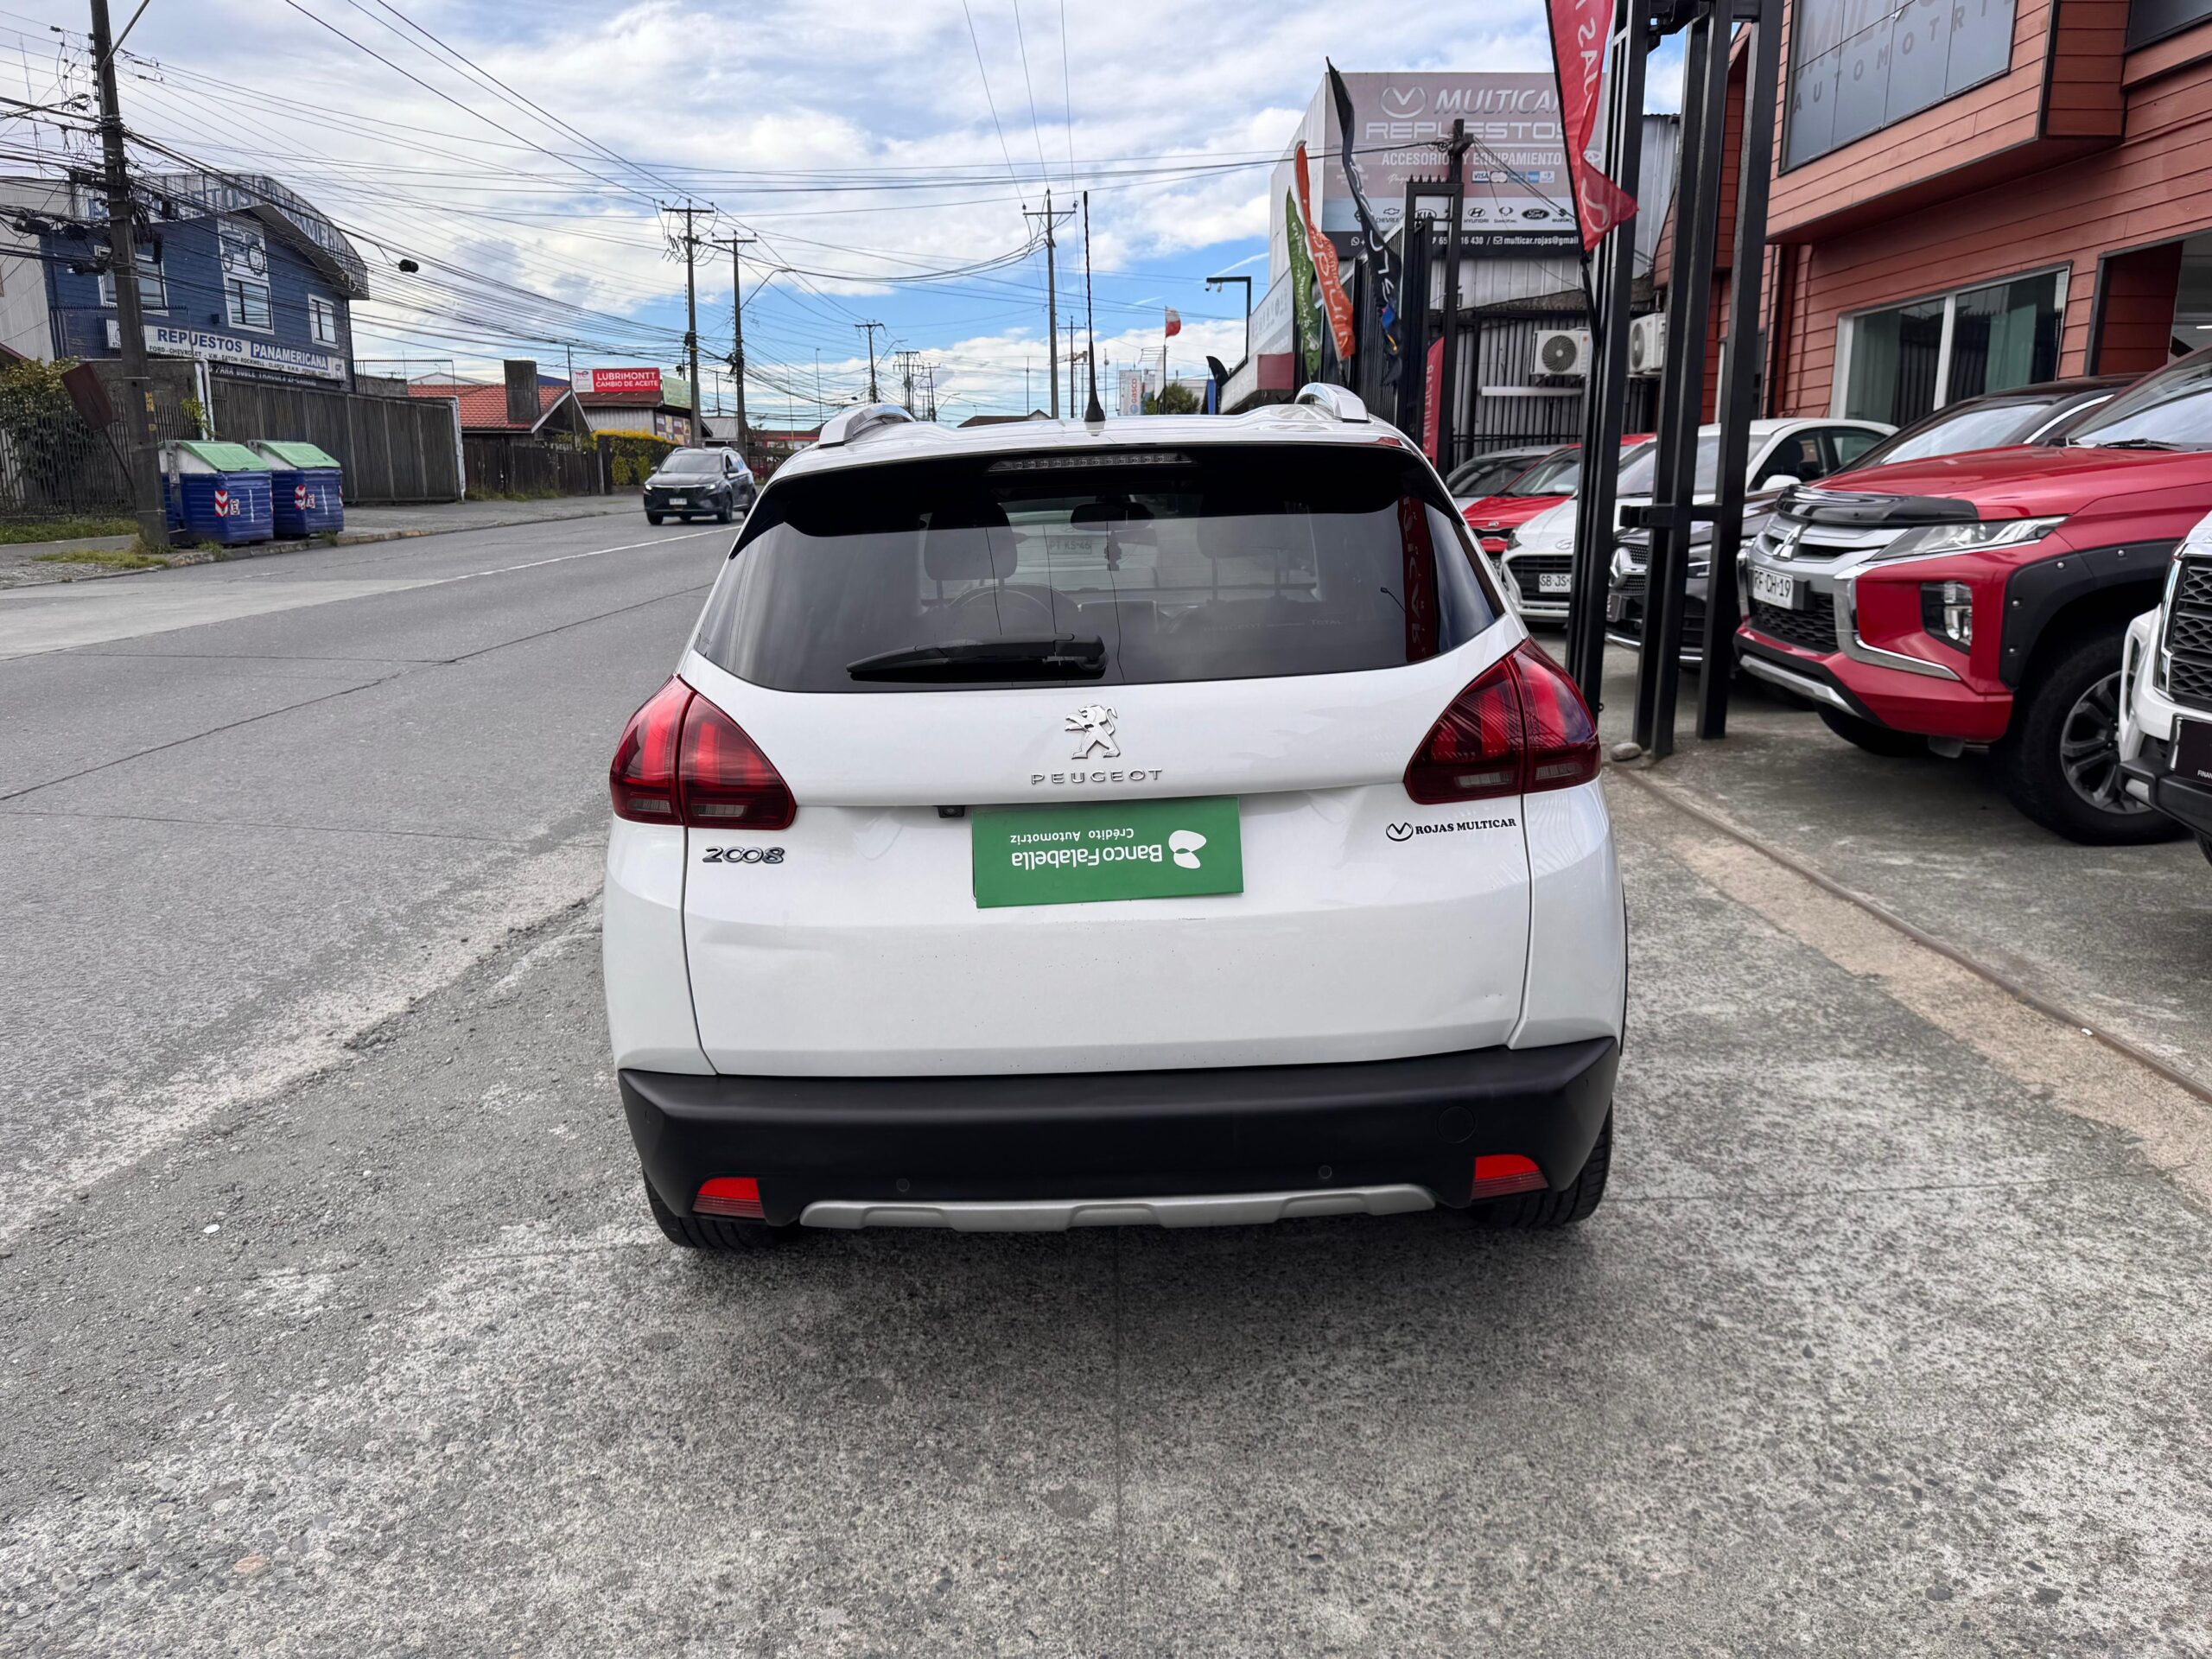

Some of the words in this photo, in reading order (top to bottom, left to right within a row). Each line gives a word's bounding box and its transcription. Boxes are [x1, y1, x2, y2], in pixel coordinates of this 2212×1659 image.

[1382, 152, 1453, 166] ACCESORIO
[1473, 152, 1562, 166] EQUIPAMIENTO
[1471, 236, 1484, 245] 430
[157, 328, 243, 353] REPUESTOS
[252, 343, 327, 369] PANAMERICANA
[596, 372, 656, 381] LUBRIMONTT
[1031, 768, 1163, 785] PEUGEOT
[1088, 828, 1135, 842] Crédito
[1415, 823, 1454, 835] ROJAS
[1457, 818, 1517, 831] MULTICAR
[1010, 830, 1081, 845] Automotriz
[702, 846, 785, 864] 2008
[1011, 849, 1100, 871] Falabella
[1103, 844, 1163, 862] Banco
